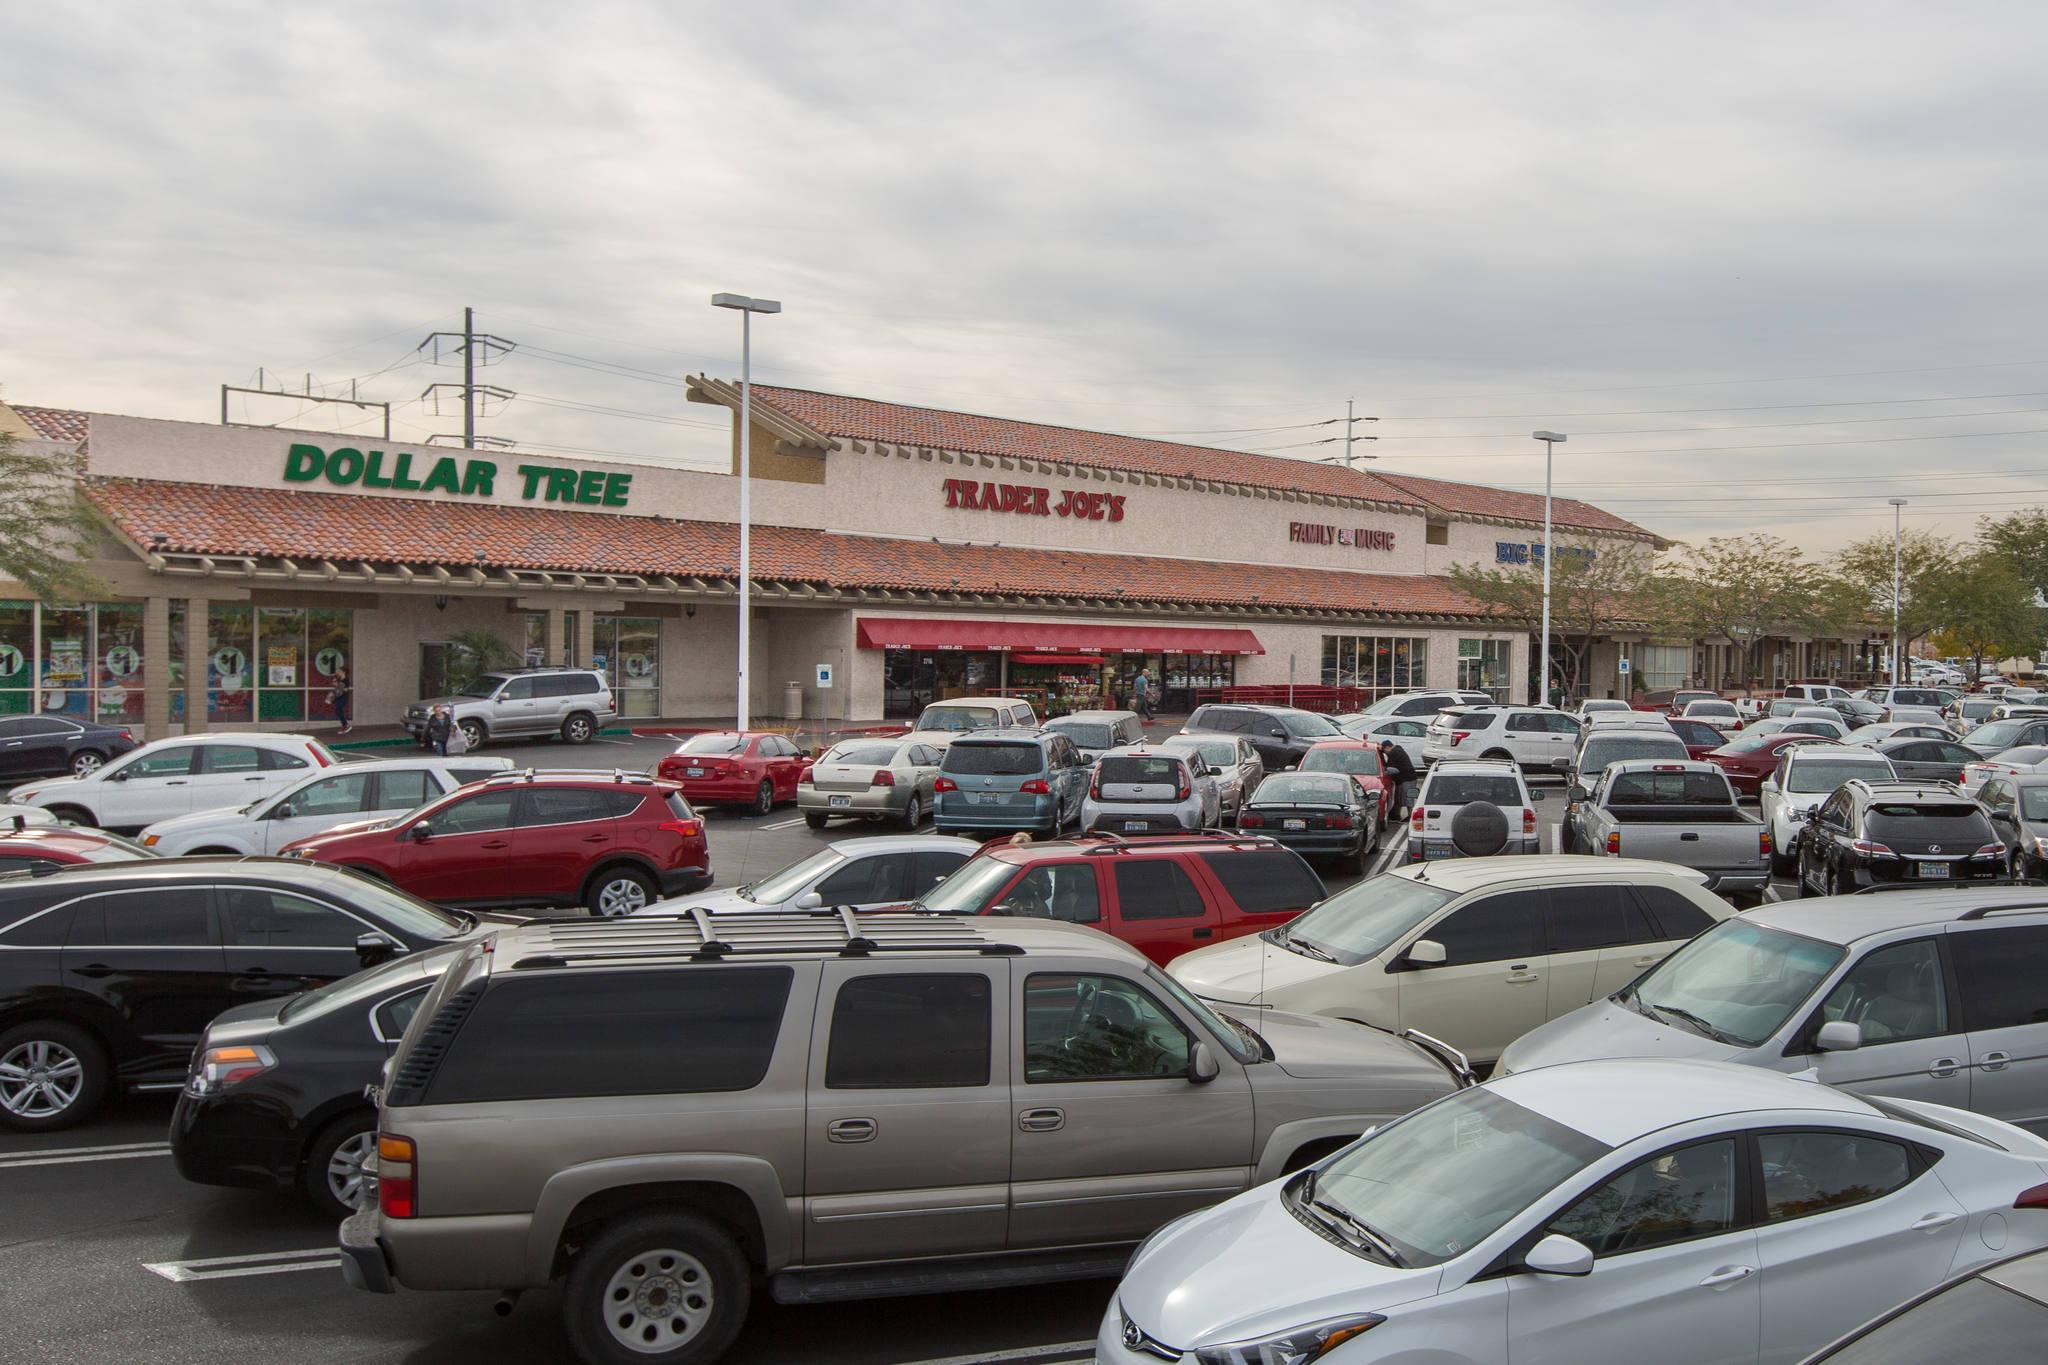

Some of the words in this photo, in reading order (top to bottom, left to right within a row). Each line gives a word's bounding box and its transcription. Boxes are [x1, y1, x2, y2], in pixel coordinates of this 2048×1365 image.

[284, 443, 497, 496] DOLLAR
[518, 464, 633, 507] TREE
[943, 478, 1051, 516] TRADER
[1055, 490, 1127, 522] JOE'S
[1290, 521, 1337, 546] FAMILY
[1355, 528, 1397, 551] MUSIC
[1496, 542, 1528, 566] BIG
